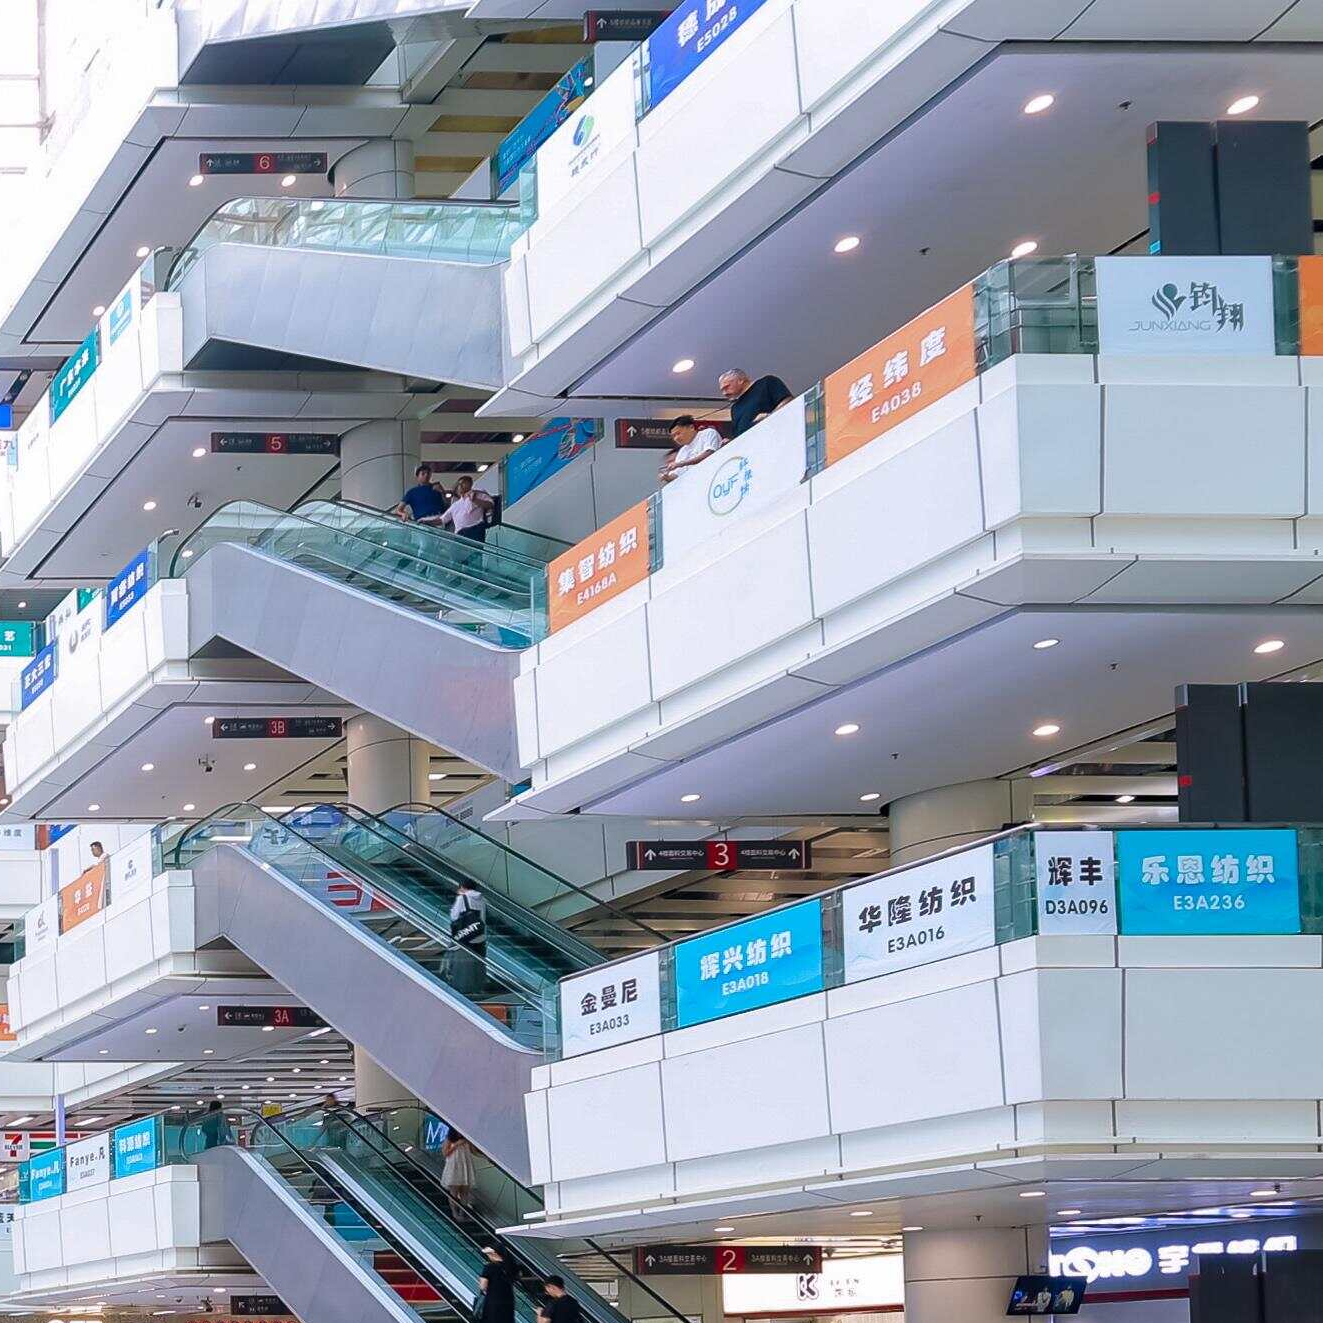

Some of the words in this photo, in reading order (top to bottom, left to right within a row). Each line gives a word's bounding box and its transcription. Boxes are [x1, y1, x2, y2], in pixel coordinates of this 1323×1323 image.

[259, 155, 270, 169] 6
[1190, 281, 1246, 333] 钧翔
[1128, 320, 1211, 333] JUNXIANG
[846, 325, 948, 413] 经纬度
[869, 381, 923, 425] E4038
[556, 524, 639, 596] 集智纺织
[270, 719, 285, 735] 3B
[713, 843, 730, 867] 3
[1048, 856, 1103, 886] 辉丰
[1142, 855, 1275, 885] 乐恩纺织
[857, 875, 977, 934] 华隆纺织
[1045, 900, 1109, 916] D3A096
[1172, 894, 1246, 911] E3A236
[887, 926, 946, 953] E3A016
[700, 930, 793, 981] 辉兴纺织
[580, 978, 639, 1016] 金曼尼
[722, 971, 770, 997] E3A018
[589, 1014, 631, 1036] E3A033
[721, 1250, 738, 1272] 2
